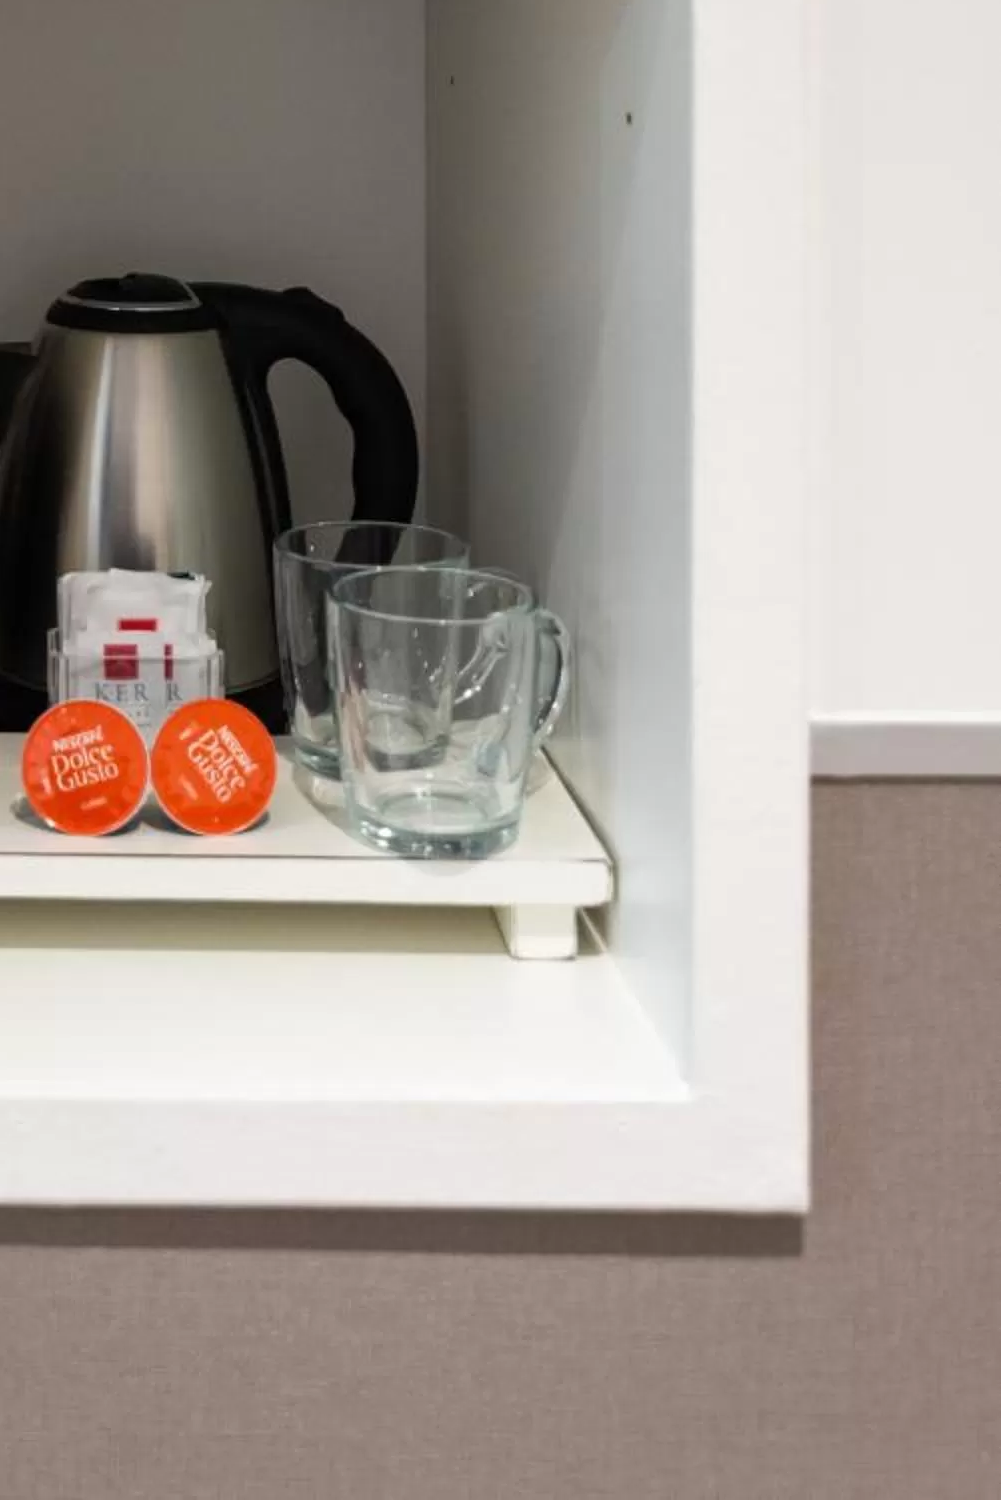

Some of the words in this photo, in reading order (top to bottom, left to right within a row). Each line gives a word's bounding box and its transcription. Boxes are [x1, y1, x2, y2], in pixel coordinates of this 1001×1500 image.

[50, 743, 116, 775] Dolce
[187, 740, 233, 804] Gusto
[56, 760, 119, 792] Gusto
